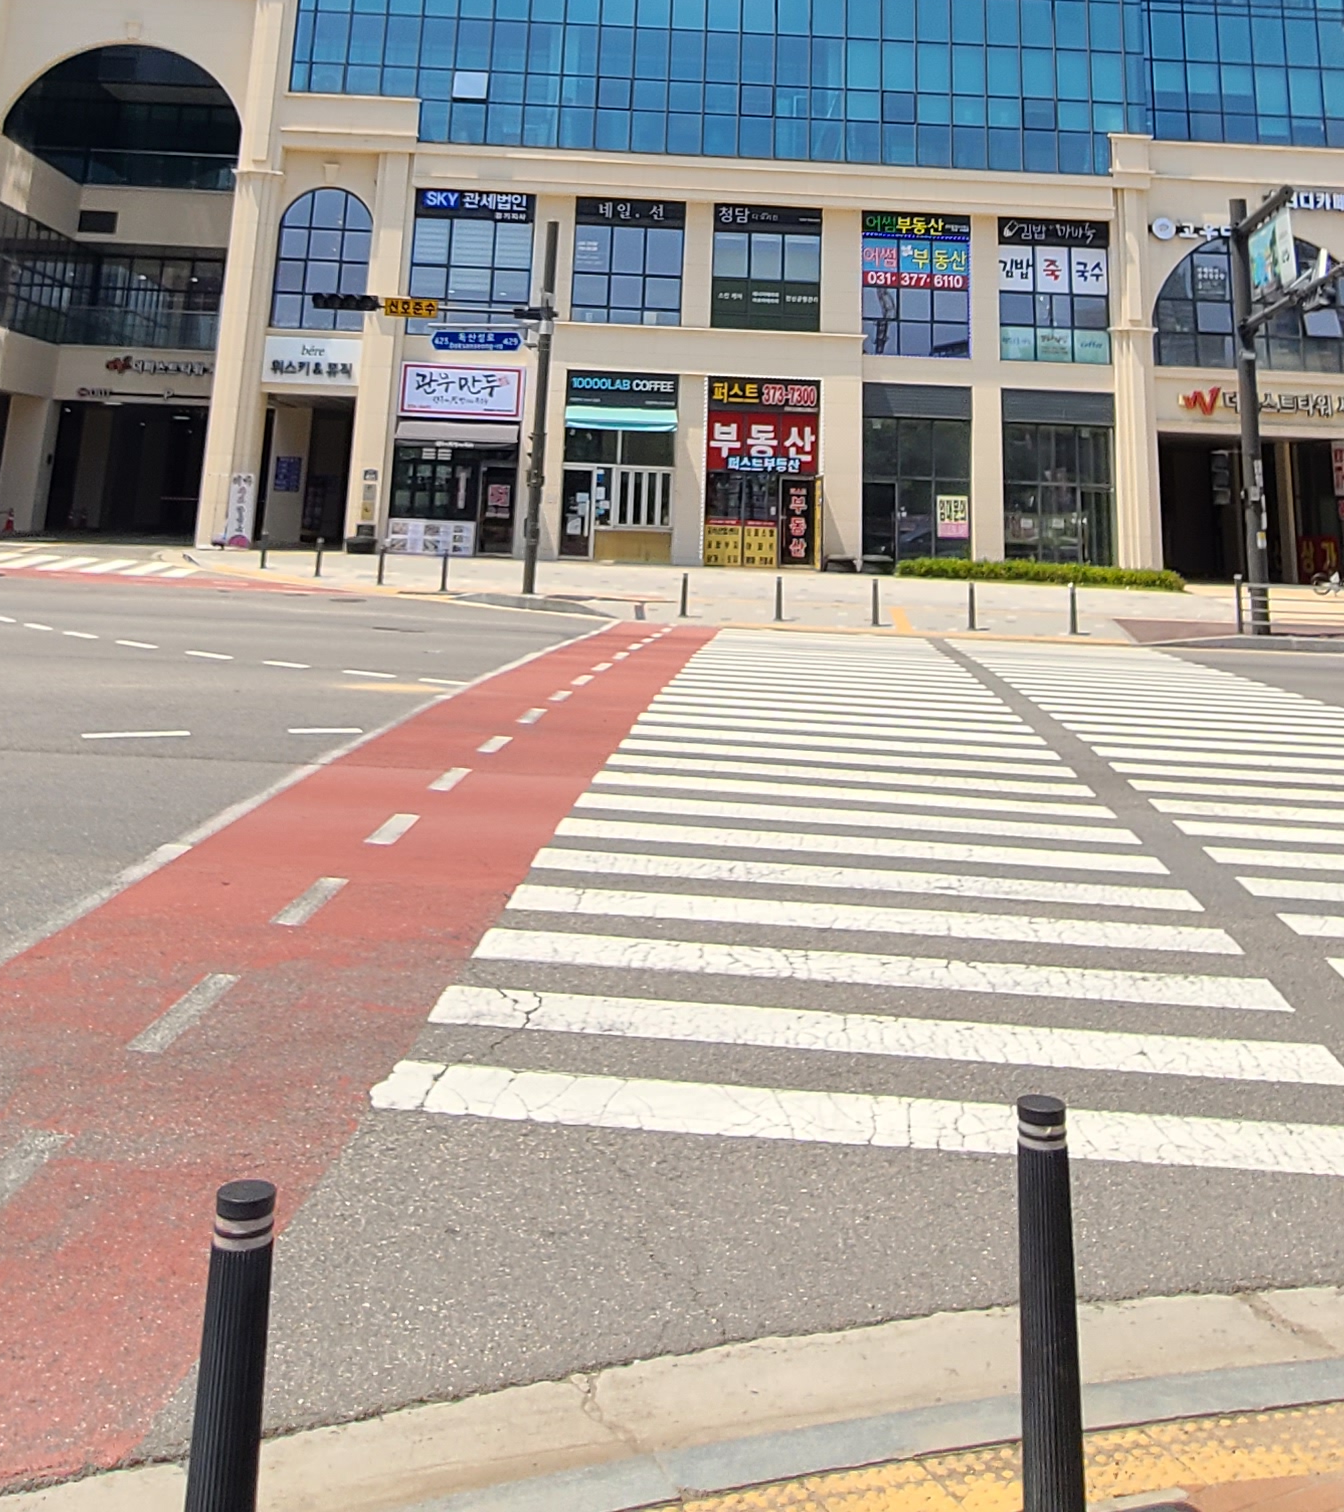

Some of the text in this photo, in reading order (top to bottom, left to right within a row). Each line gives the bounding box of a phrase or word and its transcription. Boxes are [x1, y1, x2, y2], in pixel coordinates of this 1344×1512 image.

[425, 190, 459, 208] SKY
[462, 192, 528, 212] 관세법인
[718, 205, 751, 224] 청담
[999, 258, 1104, 282] 김밥 죽 국수
[933, 275, 963, 288] 6110
[388, 301, 438, 316] 신호준수
[301, 344, 326, 357] bére
[271, 359, 311, 377] 위스키
[458, 373, 503, 398] 만두
[632, 379, 675, 393] COFFEE
[712, 381, 817, 407] 퍼스트 373-7300
[1223, 391, 1334, 418] 더스트타워
[709, 422, 817, 462] 부동산
